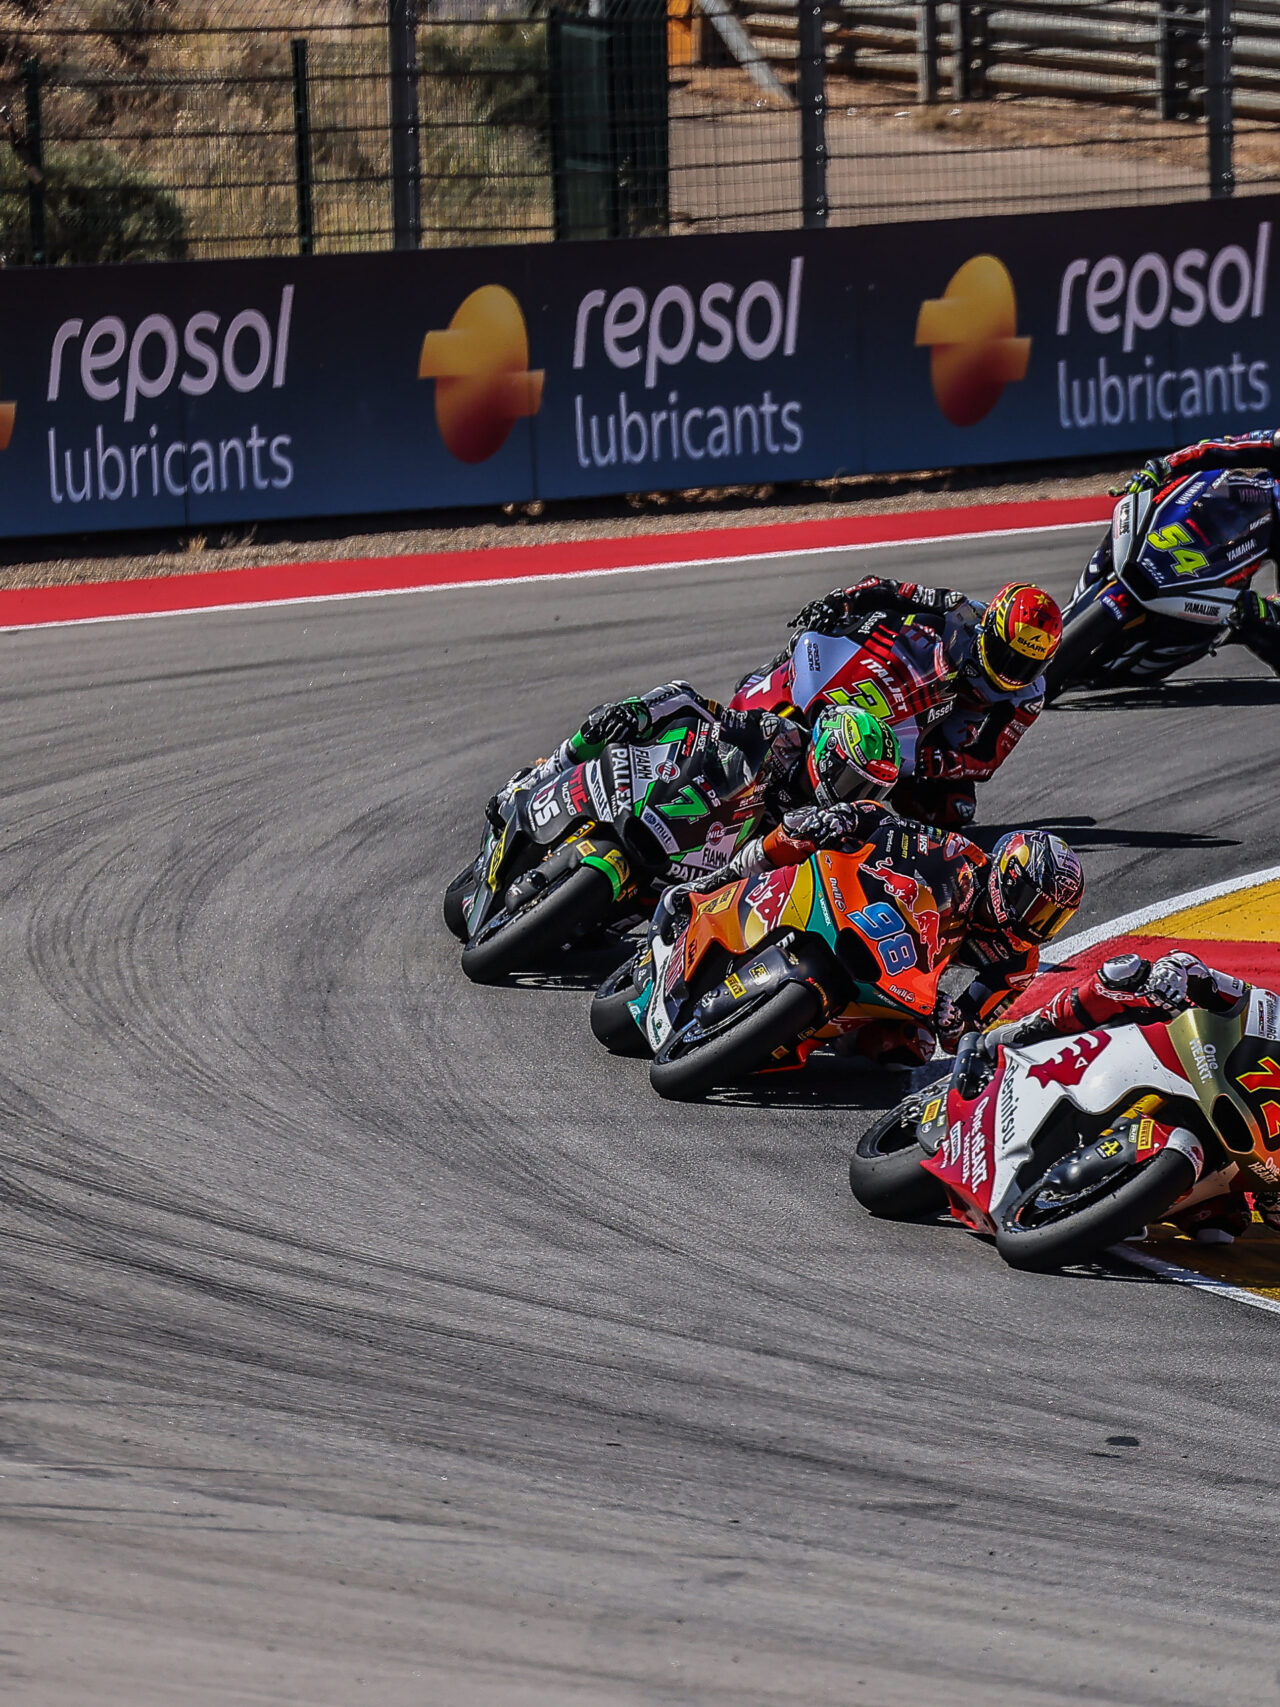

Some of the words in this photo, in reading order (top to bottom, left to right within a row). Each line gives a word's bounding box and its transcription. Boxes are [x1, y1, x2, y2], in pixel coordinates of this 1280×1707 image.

[1057, 221, 1272, 350] repsol
[573, 257, 805, 389] repsol
[47, 284, 295, 422] repsol
[1058, 352, 1271, 430] lubricants
[575, 390, 804, 467] lubricants
[47, 424, 295, 504] lubricants
[1147, 522, 1209, 578] 54
[1017, 637, 1047, 653] SHARK
[859, 658, 908, 712] ITALJET
[927, 700, 953, 724] Asset
[611, 747, 632, 816] PALLEX
[661, 759, 673, 783] NILS
[561, 781, 577, 816] RACING
[655, 784, 711, 825] 7
[654, 822, 673, 844] mut
[707, 828, 726, 841] NILS
[845, 901, 918, 976] 98
[1203, 1043, 1219, 1071] One
[973, 1096, 990, 1136] One
[1248, 1161, 1279, 1185] HEART
[1264, 1156, 1280, 1176] One
